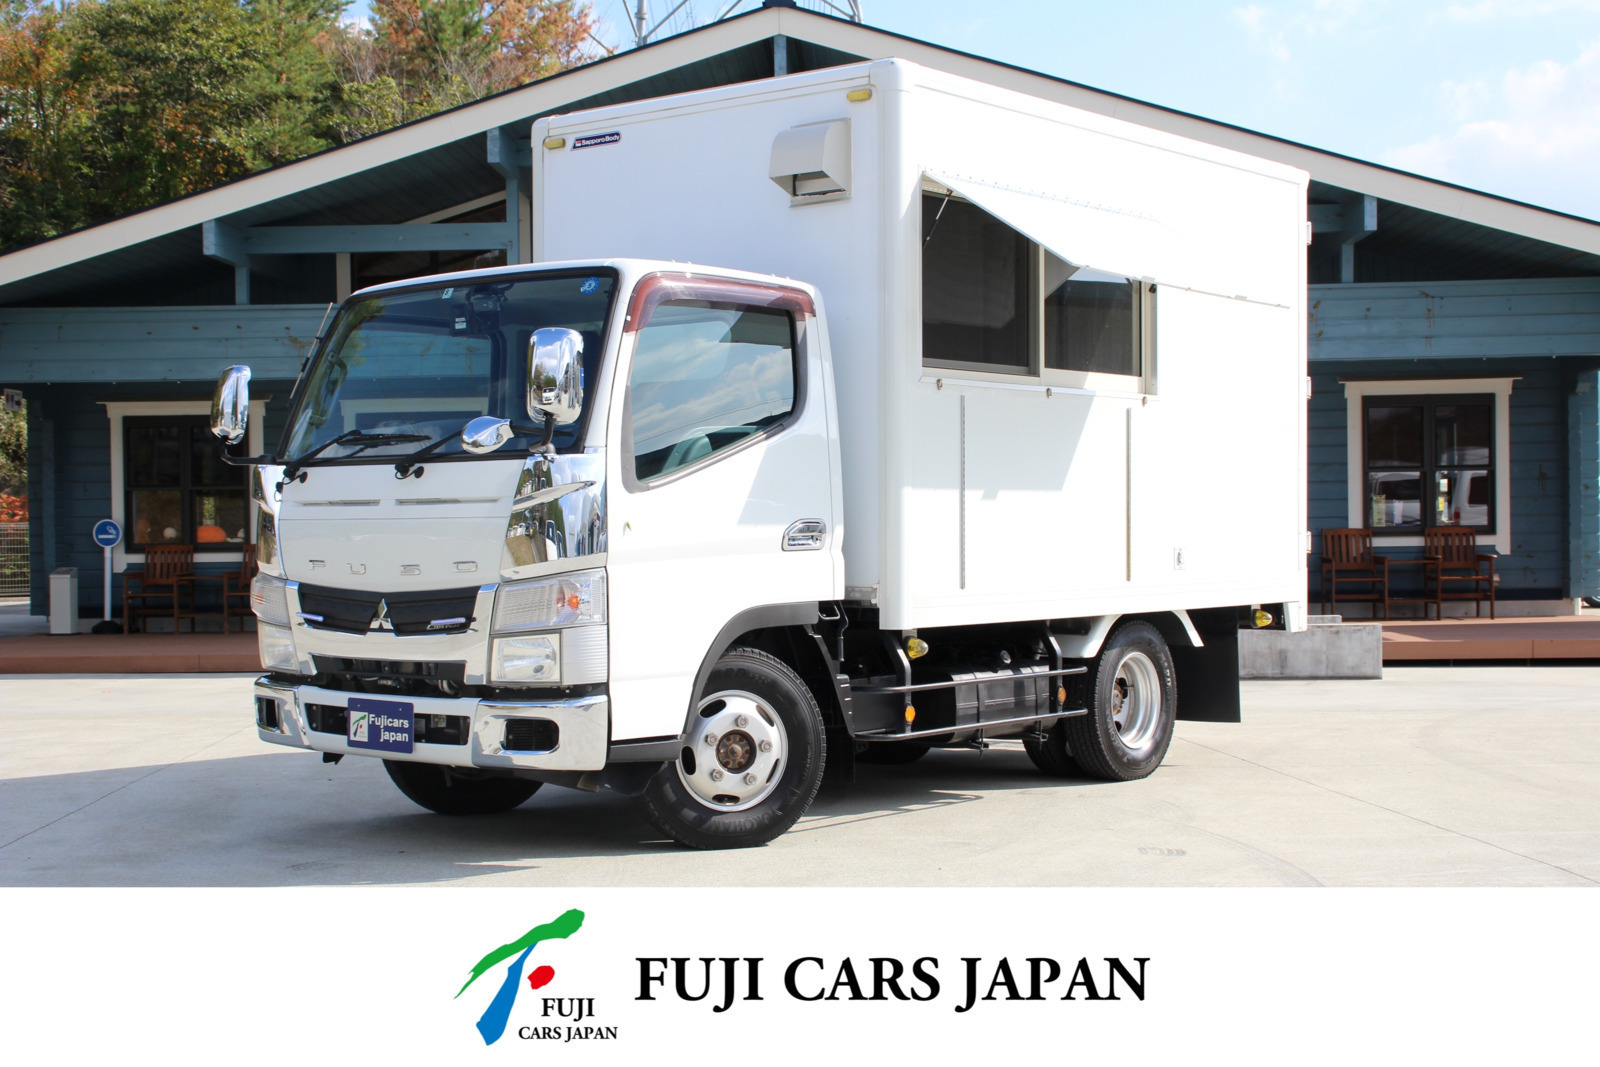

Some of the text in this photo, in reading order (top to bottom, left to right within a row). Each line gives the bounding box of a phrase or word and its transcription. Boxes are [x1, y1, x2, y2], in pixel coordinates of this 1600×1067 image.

[308, 559, 478, 576] FUSO
[369, 714, 409, 728] Fujicars
[380, 729, 409, 743] japan
